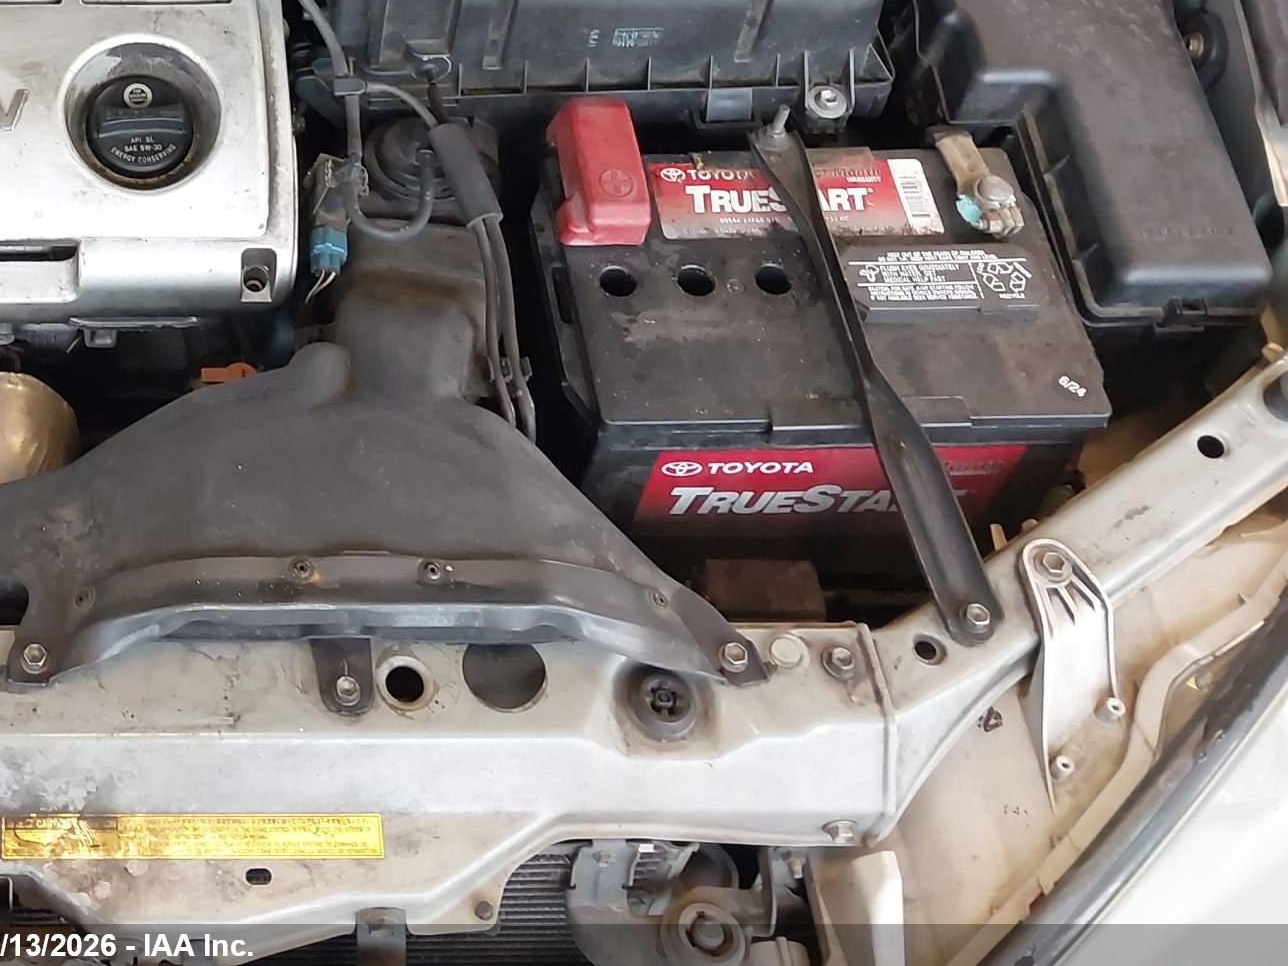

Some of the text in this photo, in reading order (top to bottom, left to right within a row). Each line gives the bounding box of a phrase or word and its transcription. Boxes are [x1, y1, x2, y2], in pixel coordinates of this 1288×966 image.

[110, 144, 176, 164] ENERGY CONSERVING
[1058, 375, 1087, 397] 6/24
[709, 461, 814, 475] TOYOTA
